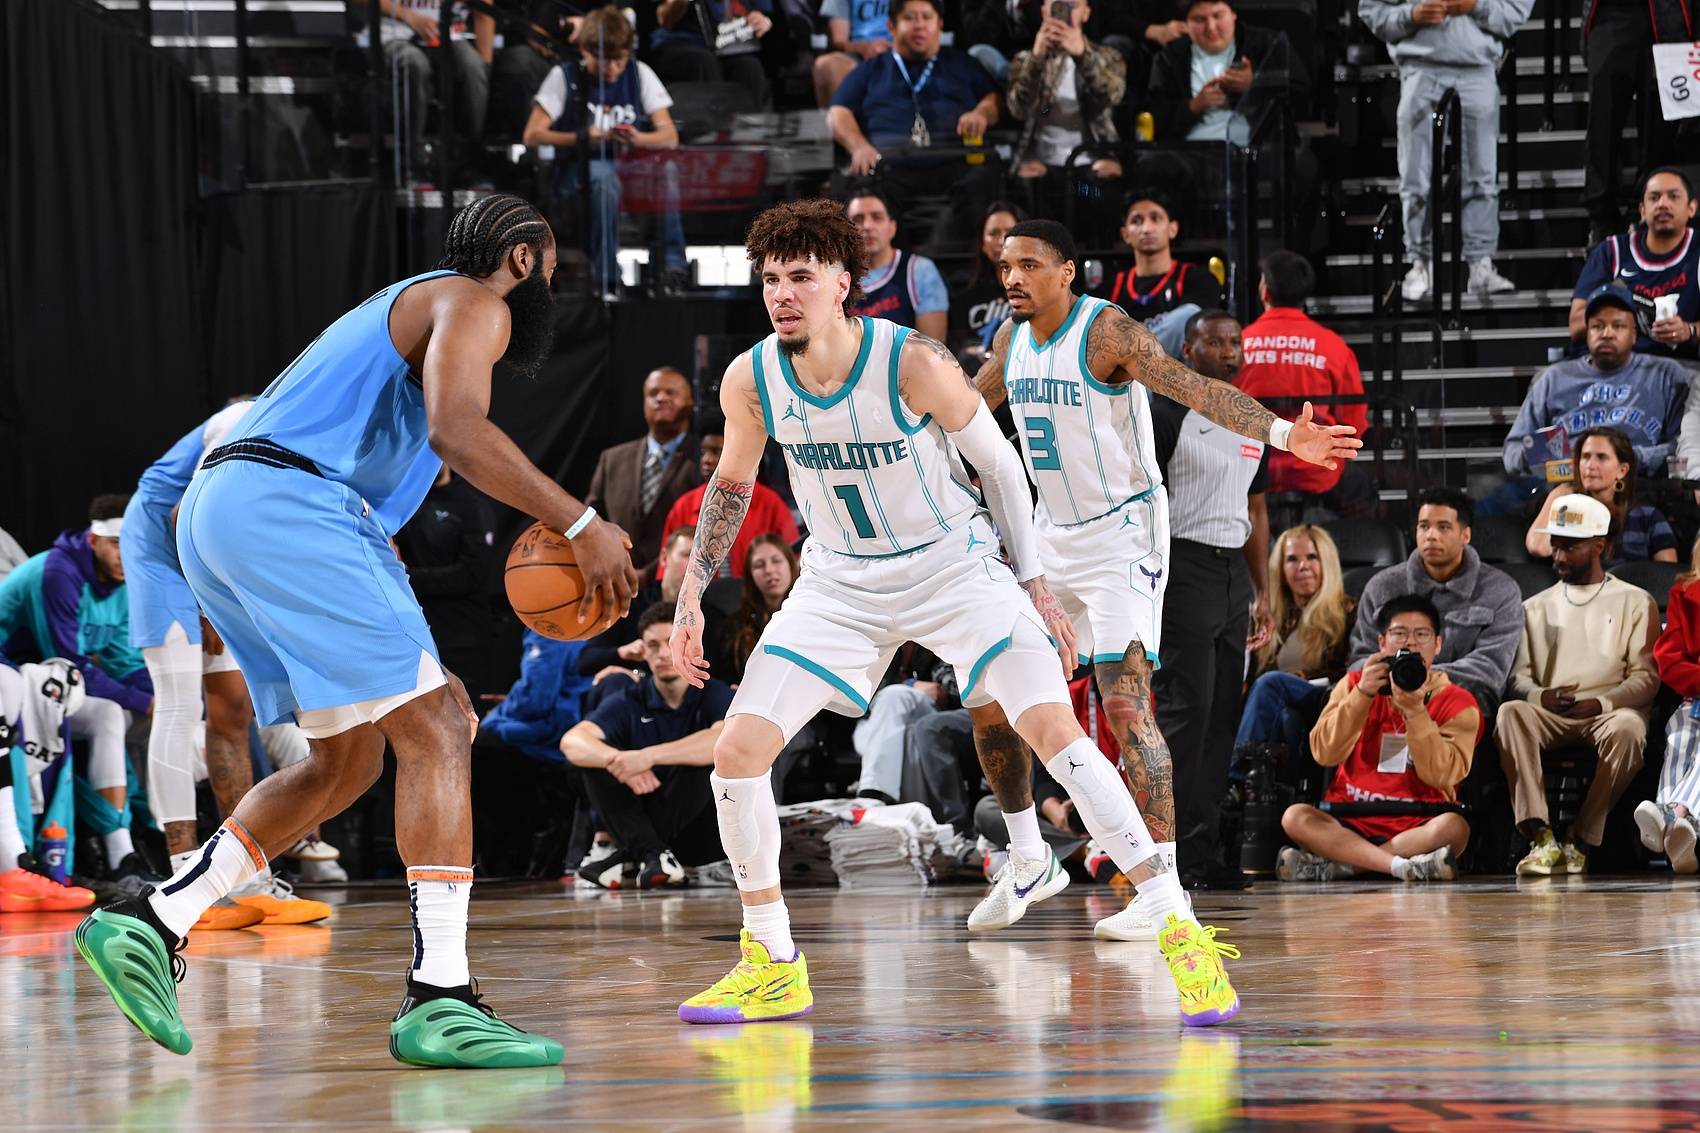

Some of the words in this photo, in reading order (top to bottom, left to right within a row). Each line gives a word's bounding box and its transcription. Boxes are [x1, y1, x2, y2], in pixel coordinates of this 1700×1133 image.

[1243, 335, 1316, 351] FANDOM
[1243, 350, 1277, 365] VES
[1281, 351, 1327, 370] HERE
[1024, 416, 1062, 471] 3
[832, 484, 877, 539] 1
